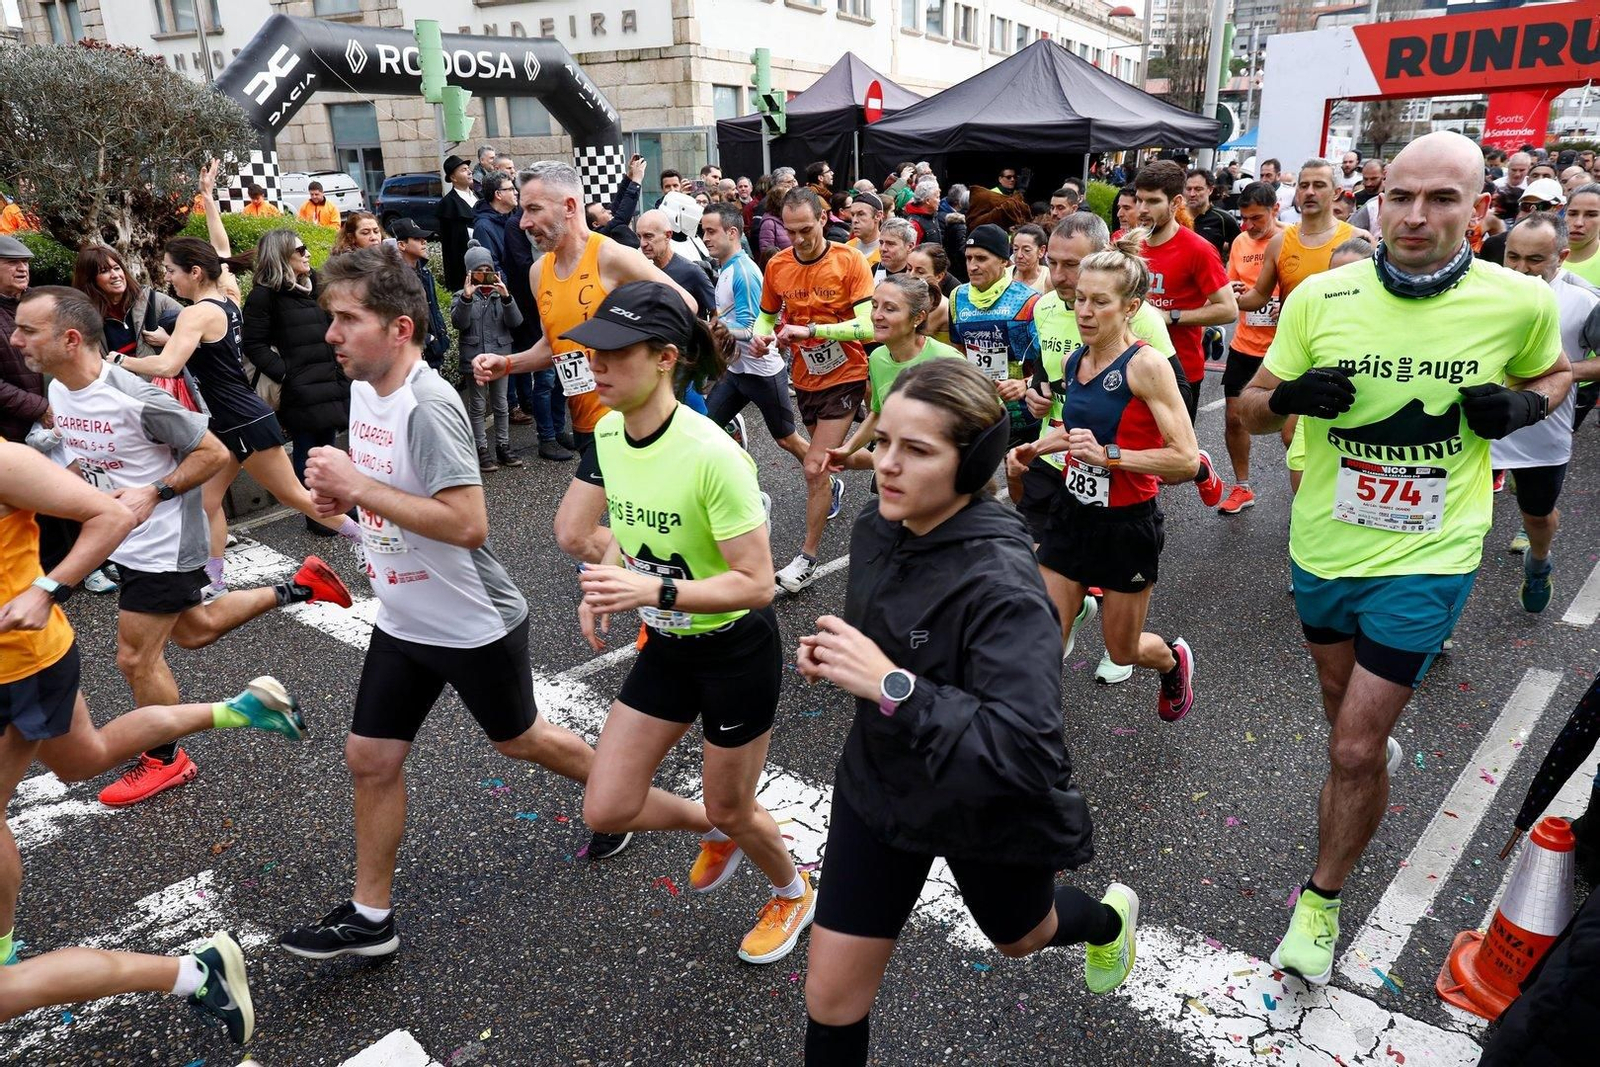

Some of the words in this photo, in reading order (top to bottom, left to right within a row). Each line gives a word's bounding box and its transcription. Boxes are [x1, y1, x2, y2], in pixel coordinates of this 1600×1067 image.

[268, 73, 316, 126] DACIA
[565, 63, 618, 123] ALPINE
[1495, 114, 1524, 125] Sports
[1491, 127, 1536, 137] Santander
[813, 287, 836, 298] Vigo
[609, 306, 642, 320] 2XU
[808, 348, 832, 364] 187
[976, 353, 992, 368] 39
[1396, 357, 1414, 383] que
[1418, 359, 1479, 384] auga
[57, 415, 114, 434] CARREIRA
[1327, 433, 1463, 461] RUNNING
[1068, 470, 1097, 497] 283
[1357, 474, 1422, 506] 574
[637, 507, 682, 534] auga
